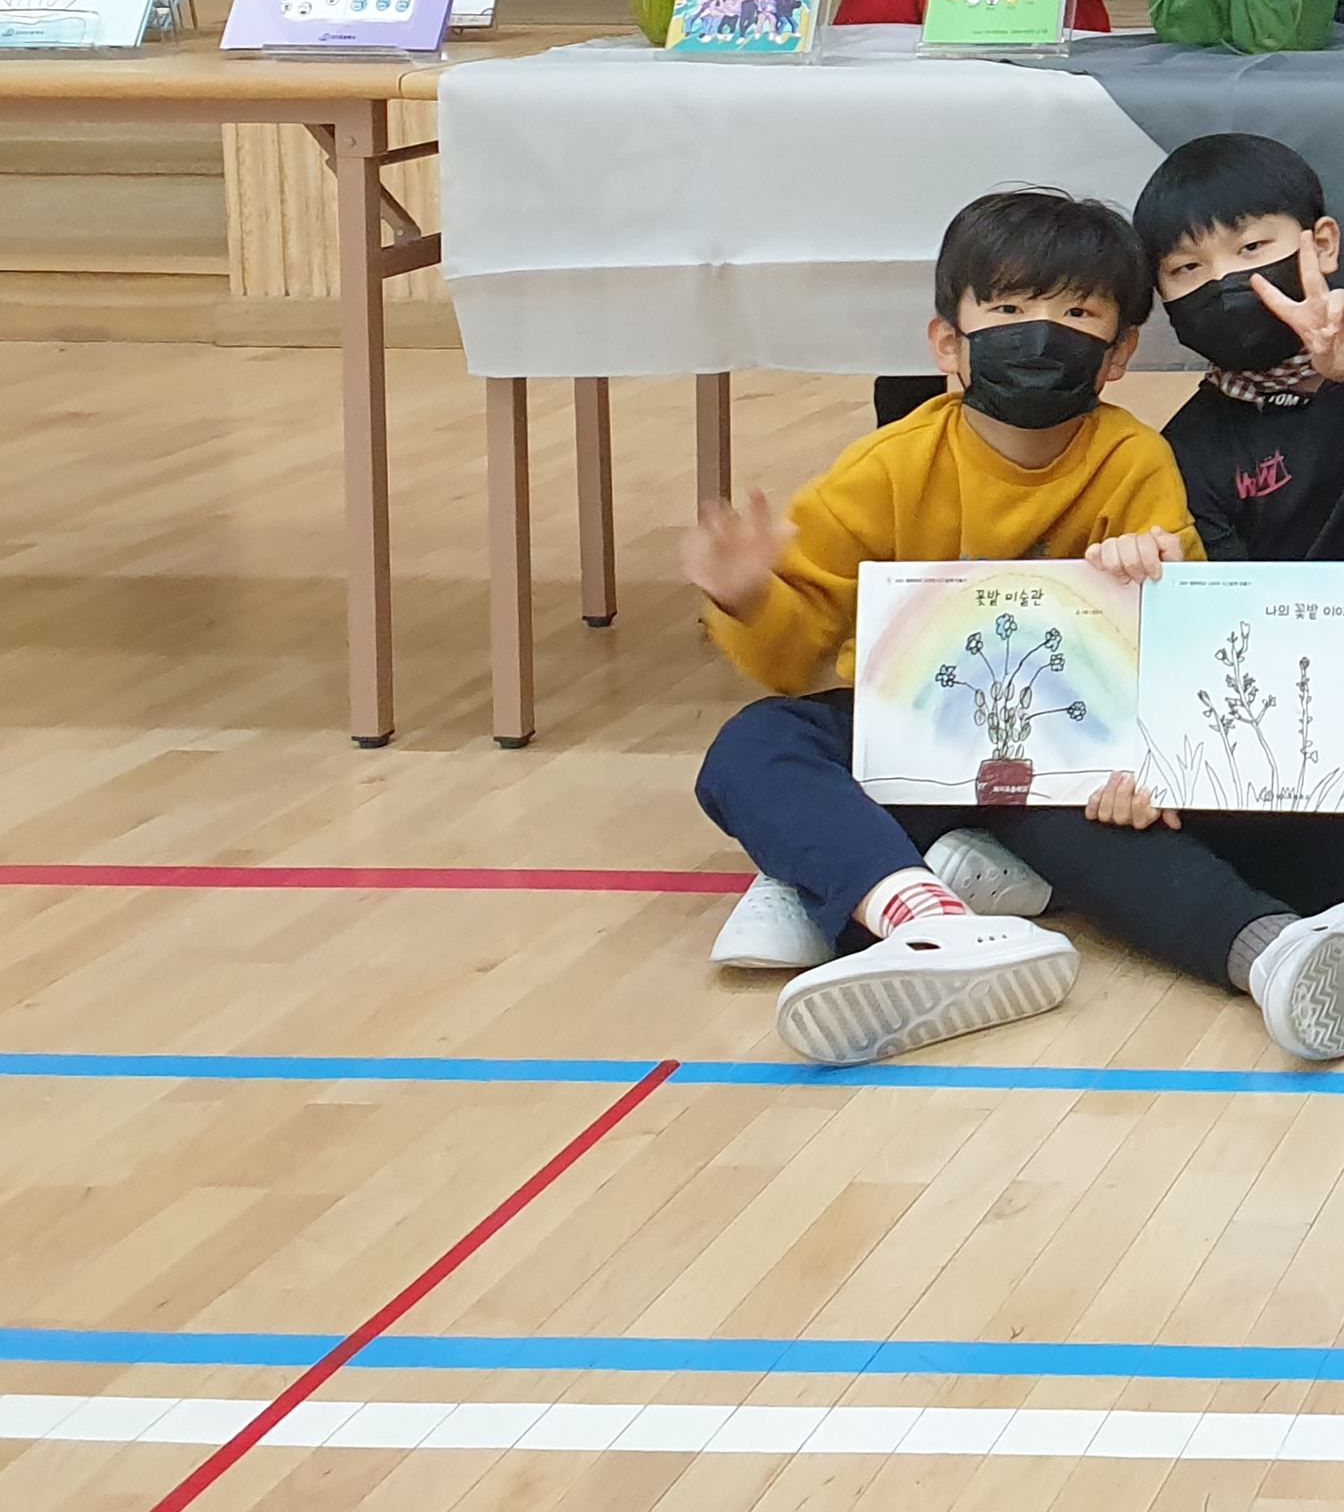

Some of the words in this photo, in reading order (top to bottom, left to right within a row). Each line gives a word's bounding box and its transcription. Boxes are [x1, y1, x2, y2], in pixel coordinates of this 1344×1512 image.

[975, 588, 1000, 607] 꽃밭
[1005, 588, 1045, 607] 미술관
[1265, 605, 1290, 617] 나의
[1294, 603, 1319, 620] 꽃밭
